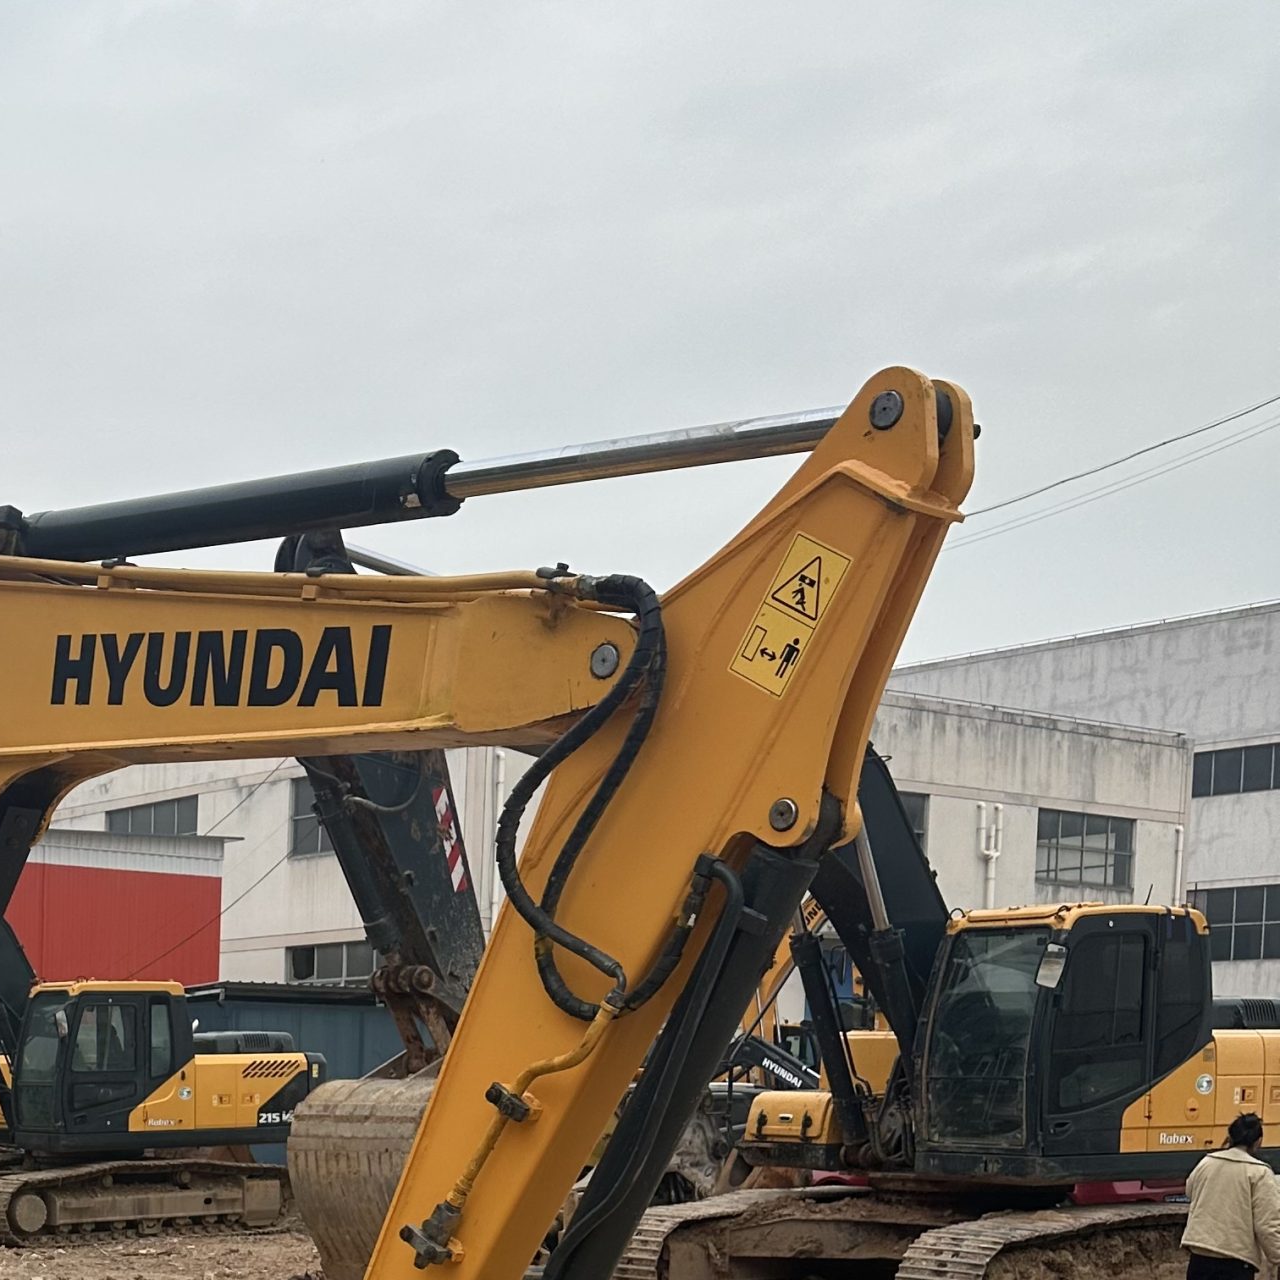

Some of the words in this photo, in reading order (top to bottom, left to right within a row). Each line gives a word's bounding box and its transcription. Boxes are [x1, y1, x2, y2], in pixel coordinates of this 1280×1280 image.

[50, 624, 392, 707] HYUNDAI
[762, 1057, 802, 1088] HYUNDAI
[258, 1112, 280, 1123] 215
[1159, 1132, 1194, 1145] Robex
